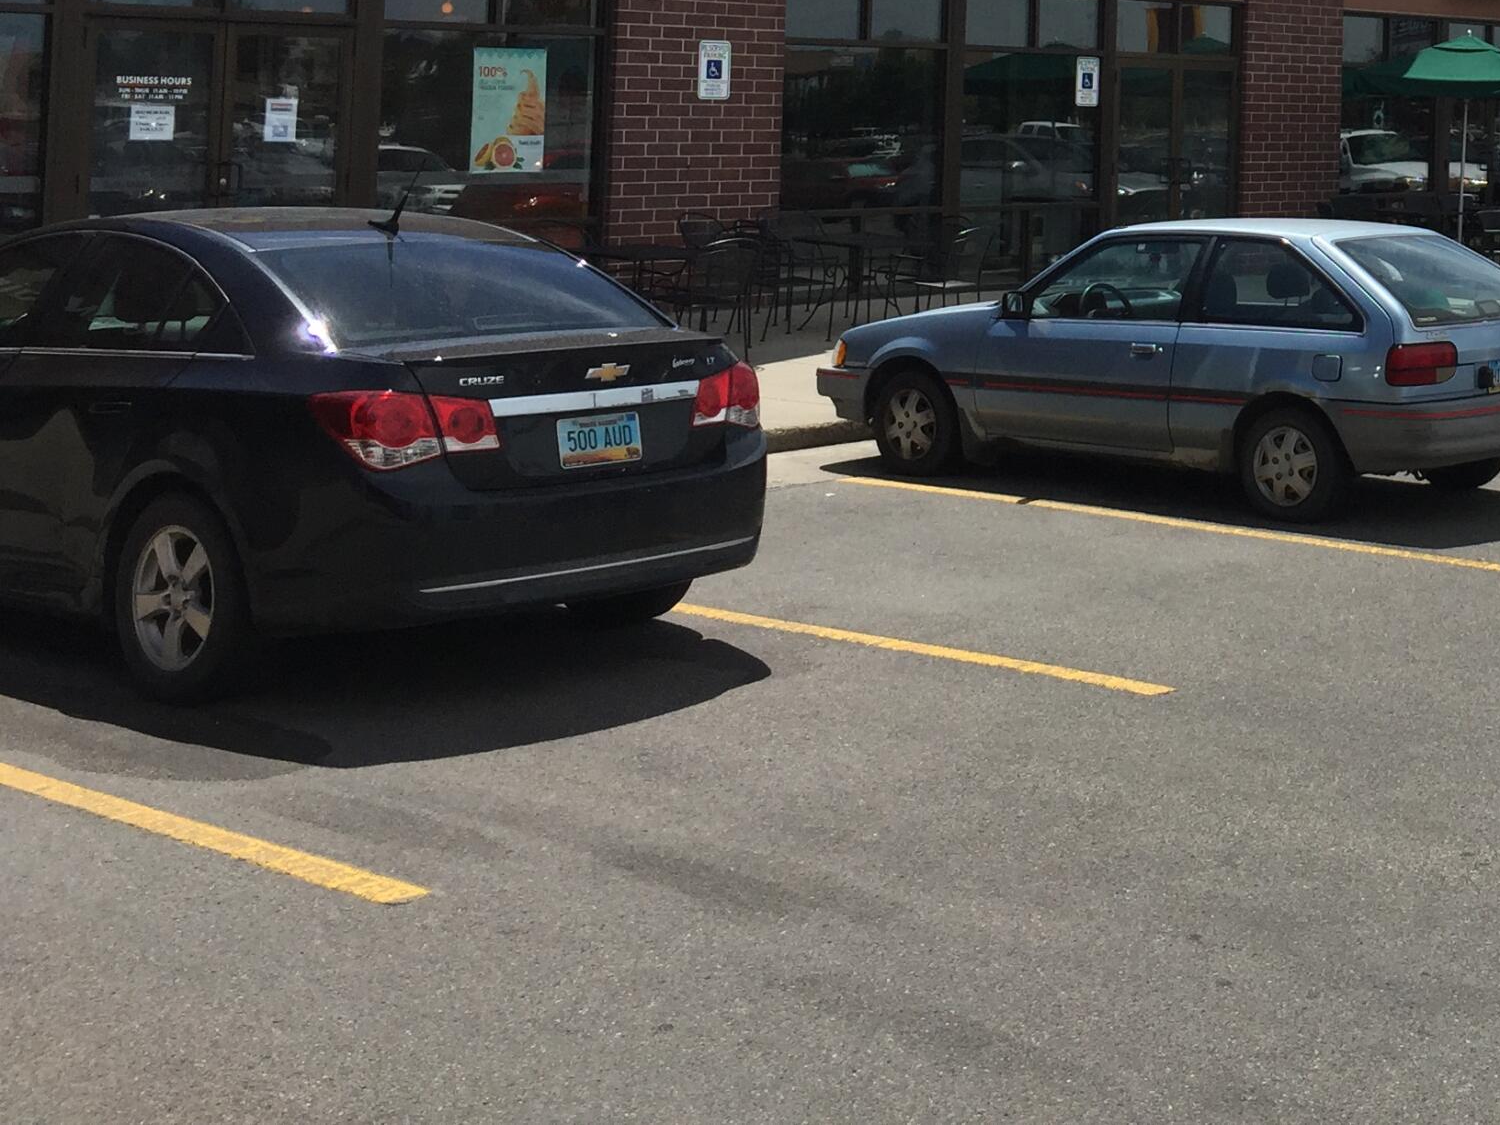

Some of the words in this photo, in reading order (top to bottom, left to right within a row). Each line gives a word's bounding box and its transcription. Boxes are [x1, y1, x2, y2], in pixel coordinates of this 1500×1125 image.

[478, 65, 508, 78] 100%
[116, 75, 159, 85] BUSINESS
[160, 76, 192, 85] HOURS
[459, 375, 505, 387] CRUZE
[567, 428, 598, 452] 500
[604, 425, 633, 448] AUD
